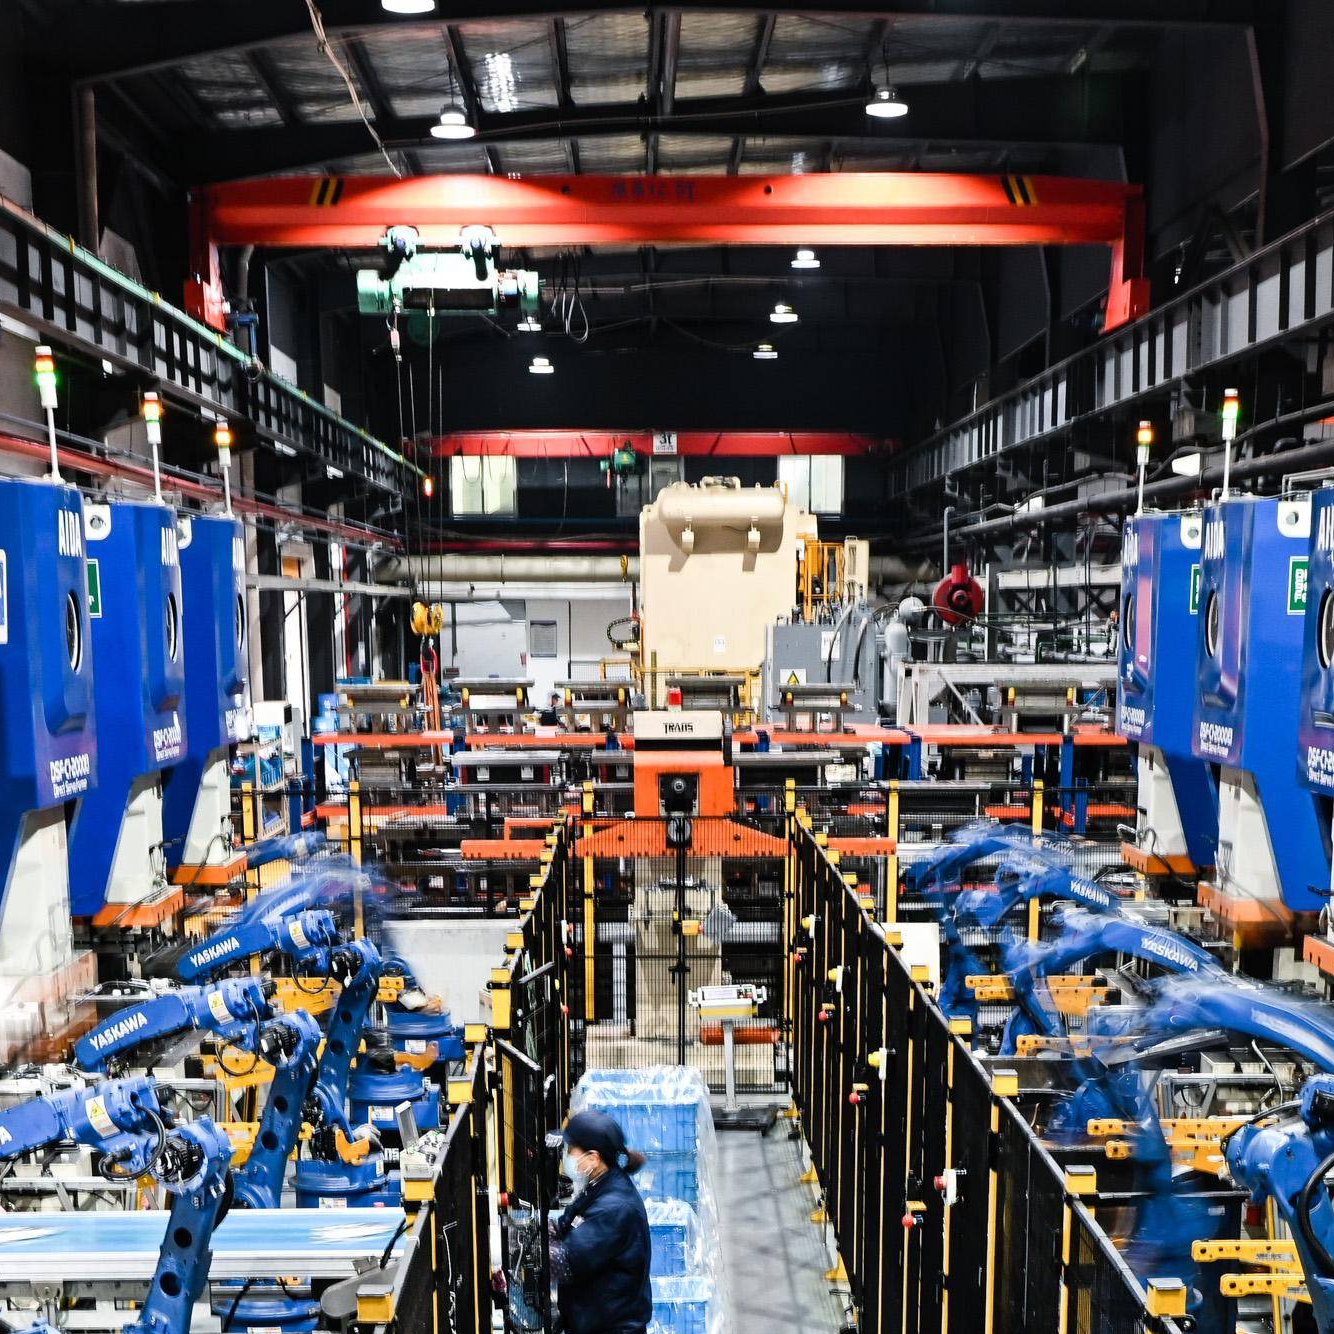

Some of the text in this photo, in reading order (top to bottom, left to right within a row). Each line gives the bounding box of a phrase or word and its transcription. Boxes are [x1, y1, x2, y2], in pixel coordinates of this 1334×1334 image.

[58, 509, 83, 558] AIDA
[1205, 521, 1225, 560] AIDA
[663, 722, 693, 734] TRANS
[1071, 879, 1109, 907] YASKAWA
[190, 936, 240, 968] YASKAWA
[1141, 936, 1198, 972] YASKAWA
[89, 1011, 148, 1051] YASKAWA
